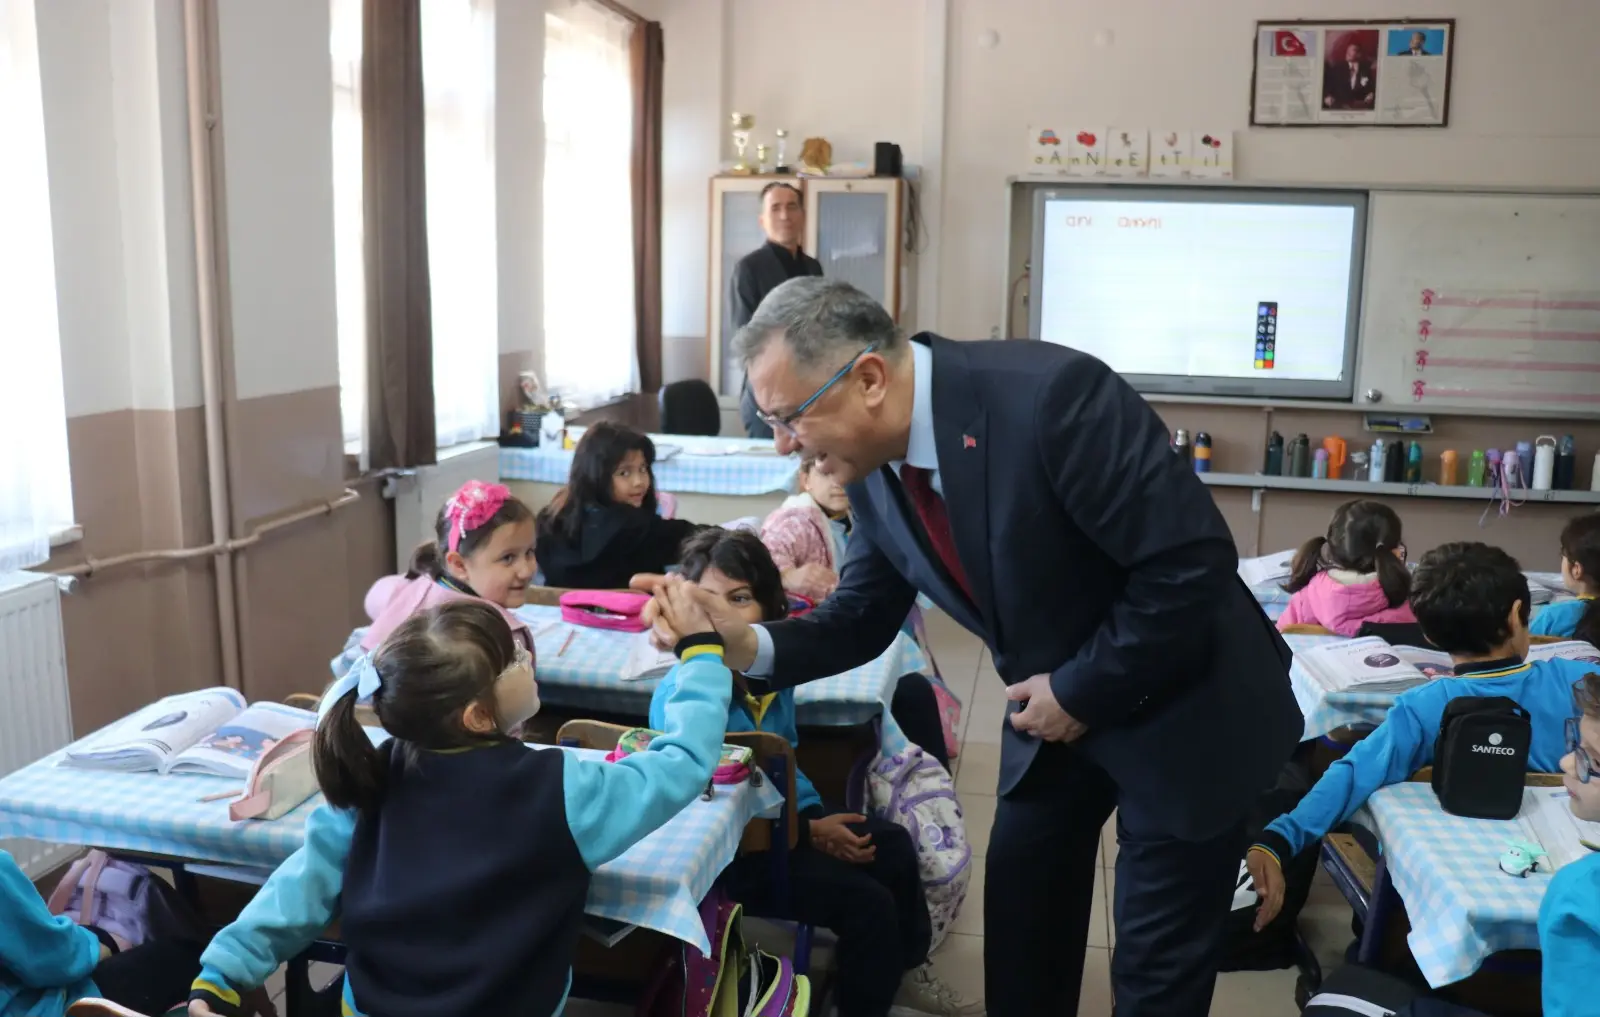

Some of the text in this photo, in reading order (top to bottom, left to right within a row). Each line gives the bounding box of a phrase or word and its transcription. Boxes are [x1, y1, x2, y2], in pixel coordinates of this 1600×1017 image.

[1049, 150, 1062, 165] A
[1086, 151, 1100, 166] N
[1129, 152, 1140, 167] E
[1173, 151, 1182, 165] T
[1471, 744, 1516, 756] SANTECO
